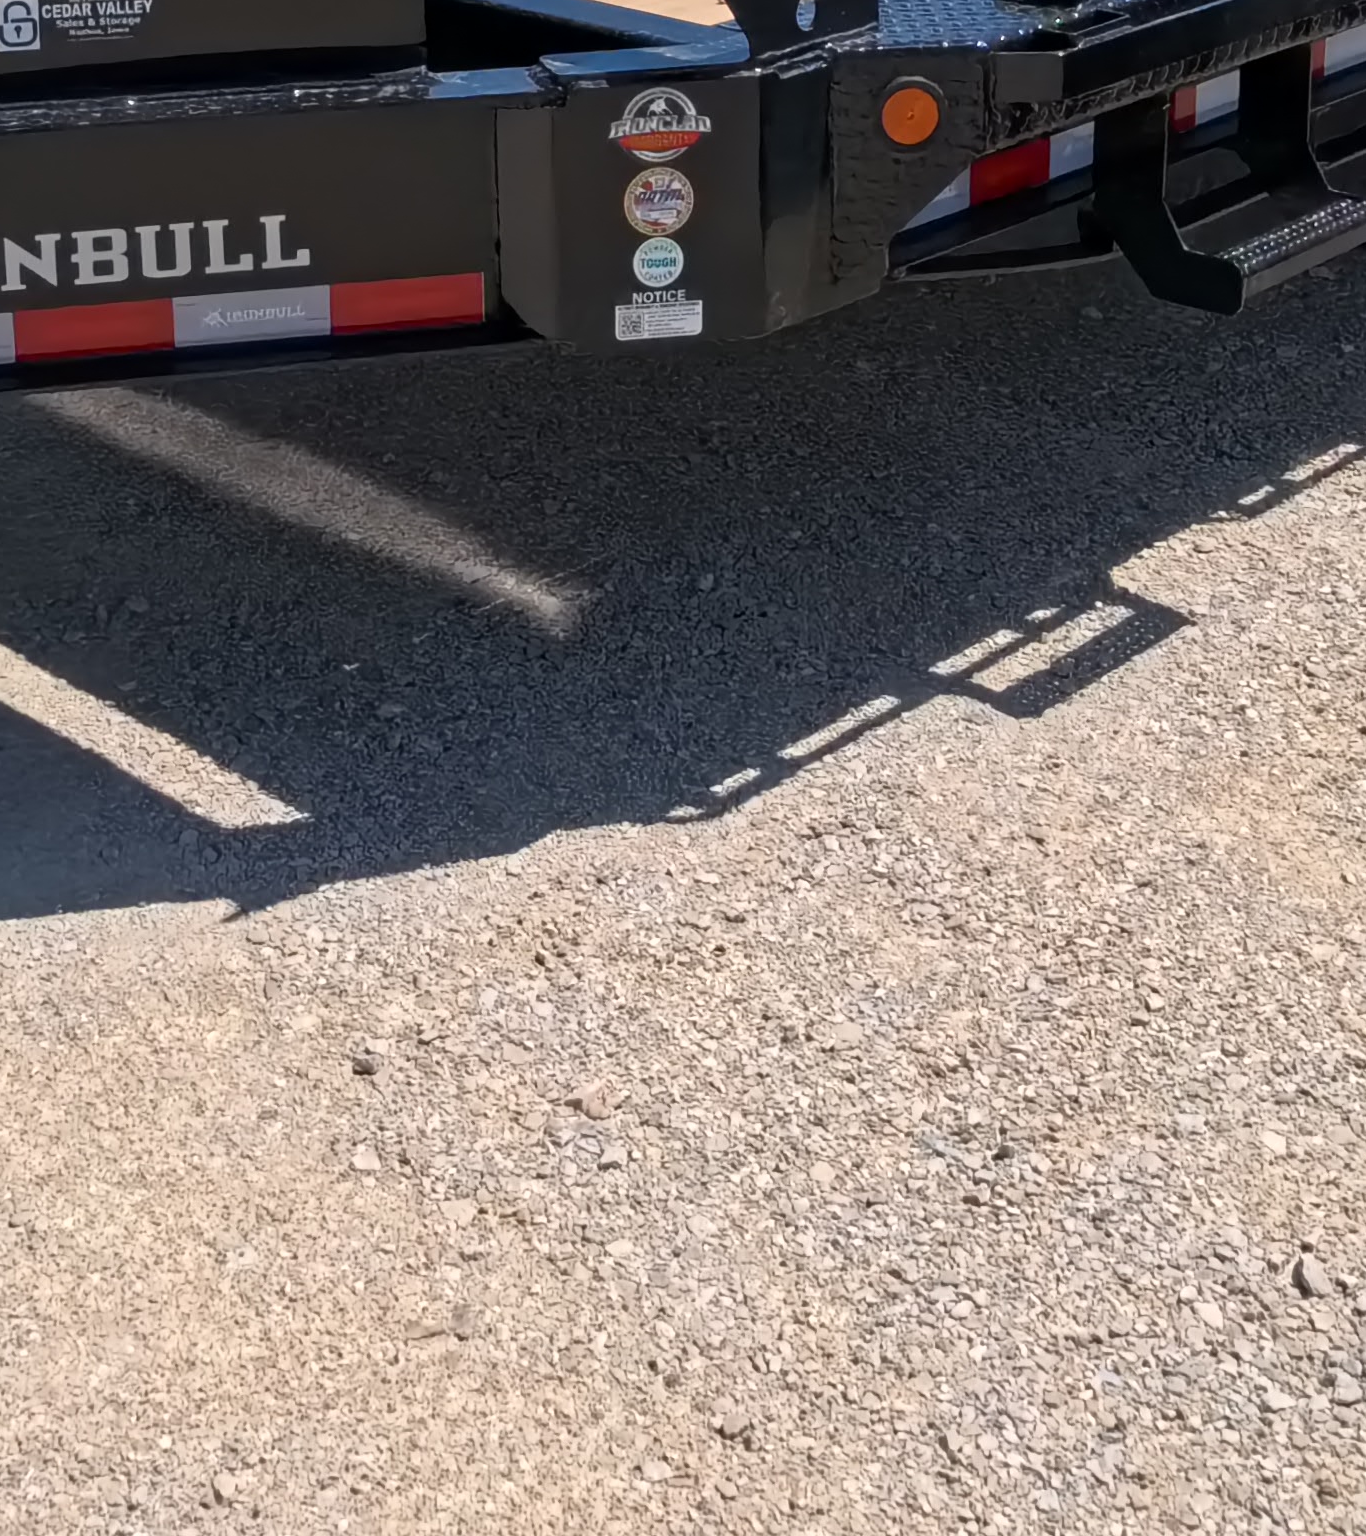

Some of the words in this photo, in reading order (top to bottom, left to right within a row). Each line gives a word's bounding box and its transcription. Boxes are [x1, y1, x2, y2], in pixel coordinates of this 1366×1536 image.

[41, 2, 92, 19] CEDAR
[56, 19, 85, 28] Sales
[99, 16, 142, 26] Storage
[640, 256, 677, 270] TOUGH
[632, 289, 687, 304] NOTICE
